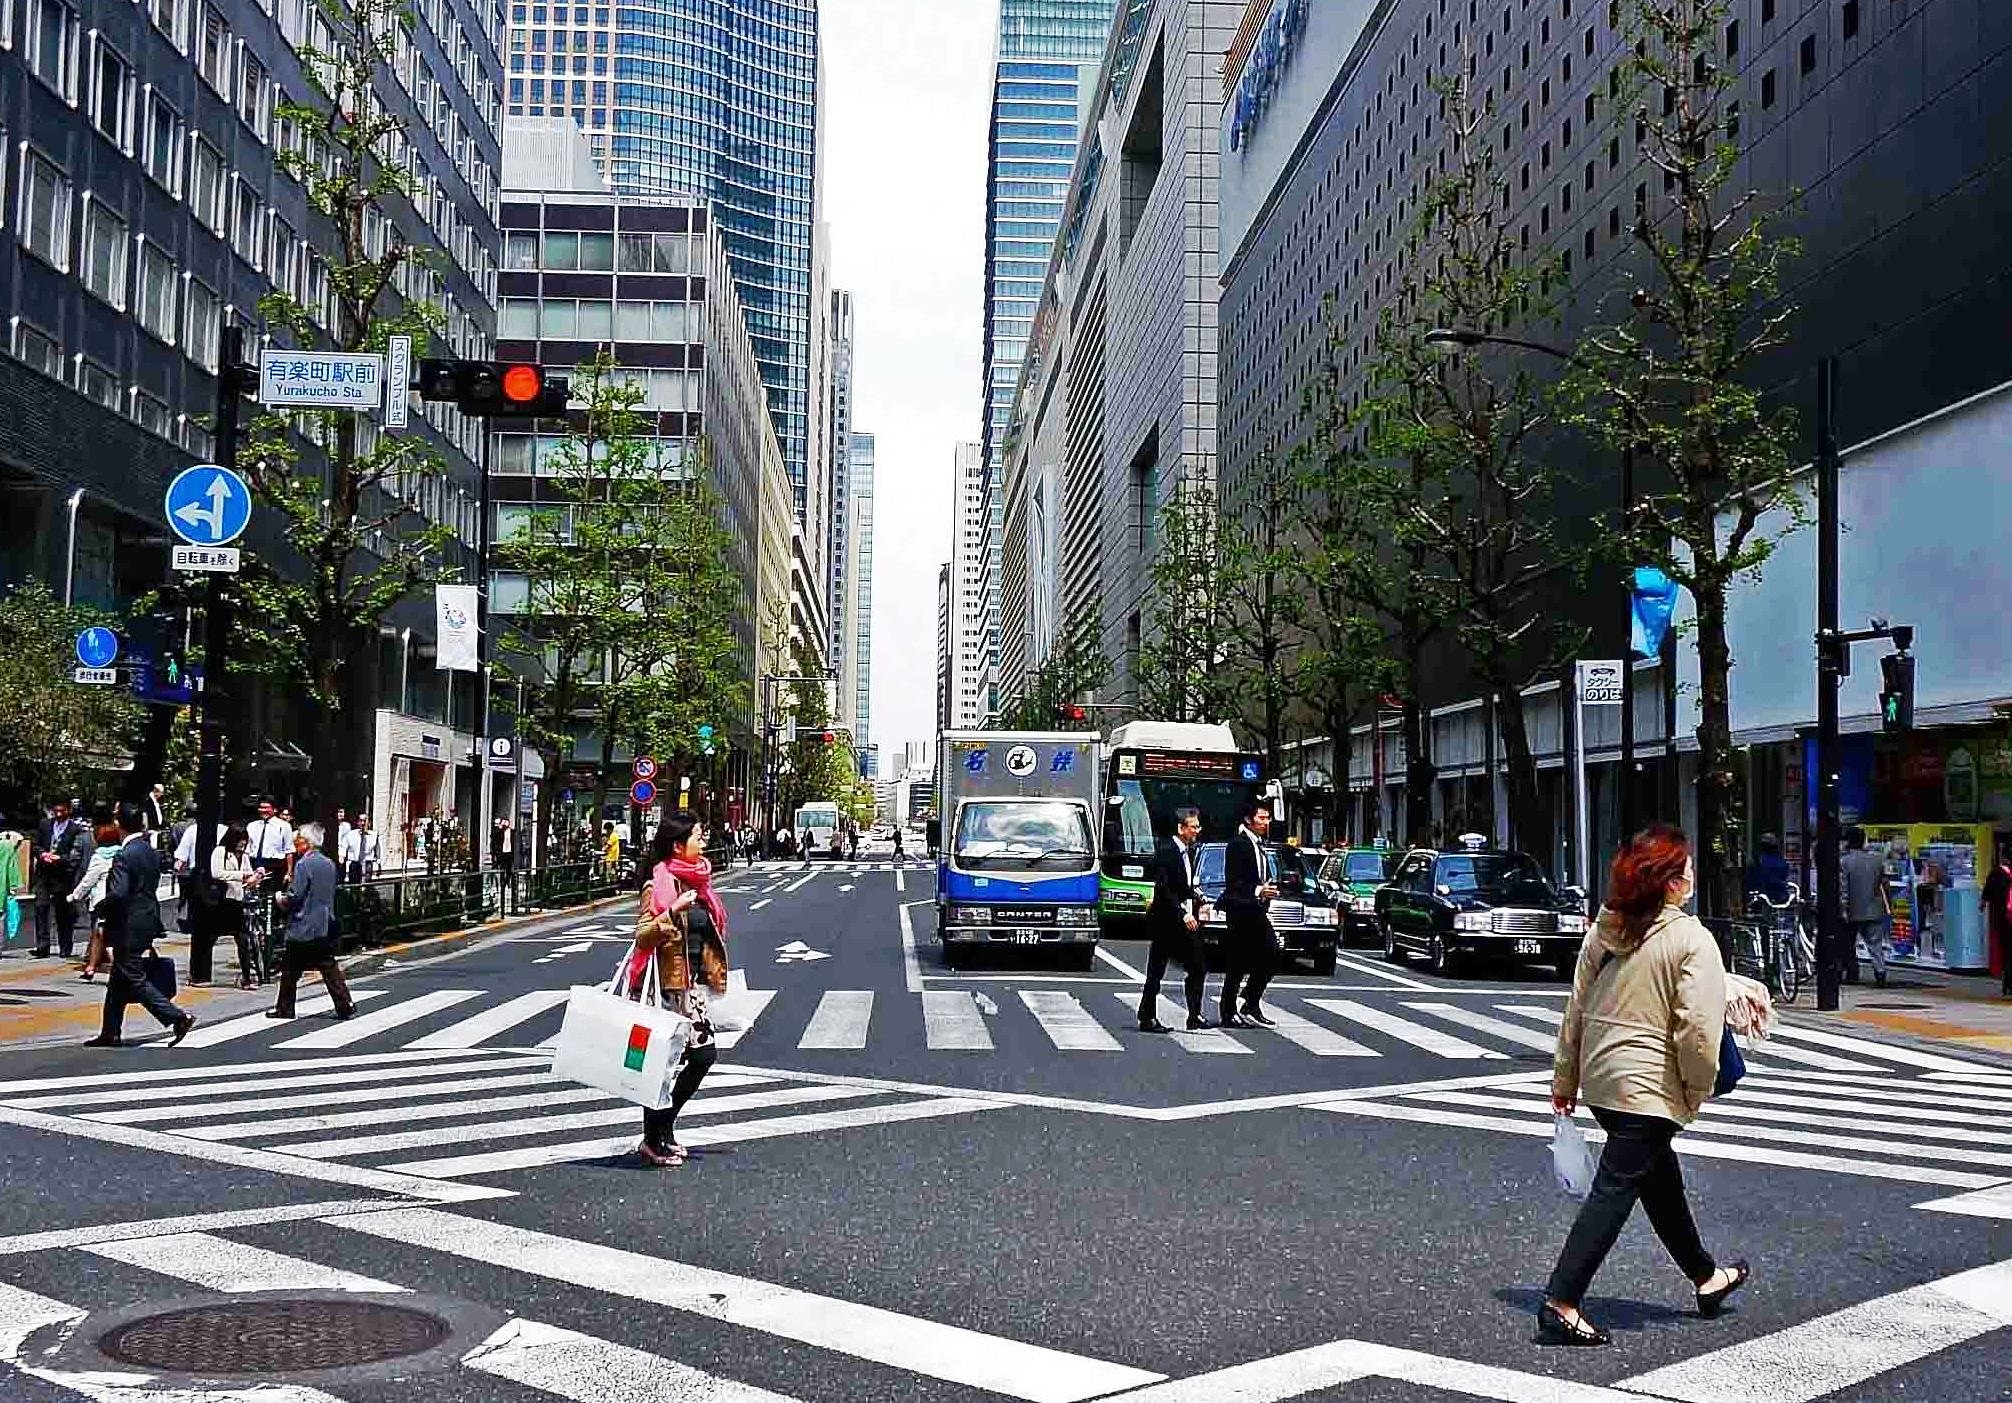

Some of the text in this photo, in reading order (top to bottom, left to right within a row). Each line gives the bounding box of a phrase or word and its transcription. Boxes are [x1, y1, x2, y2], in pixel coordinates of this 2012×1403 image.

[266, 359, 376, 384] 有楽町駅前
[391, 341, 405, 423] スクランブル式
[275, 383, 362, 398] Yurakucho Sta
[177, 551, 233, 566] 自転車を除く
[1587, 677, 1619, 687] タクシー
